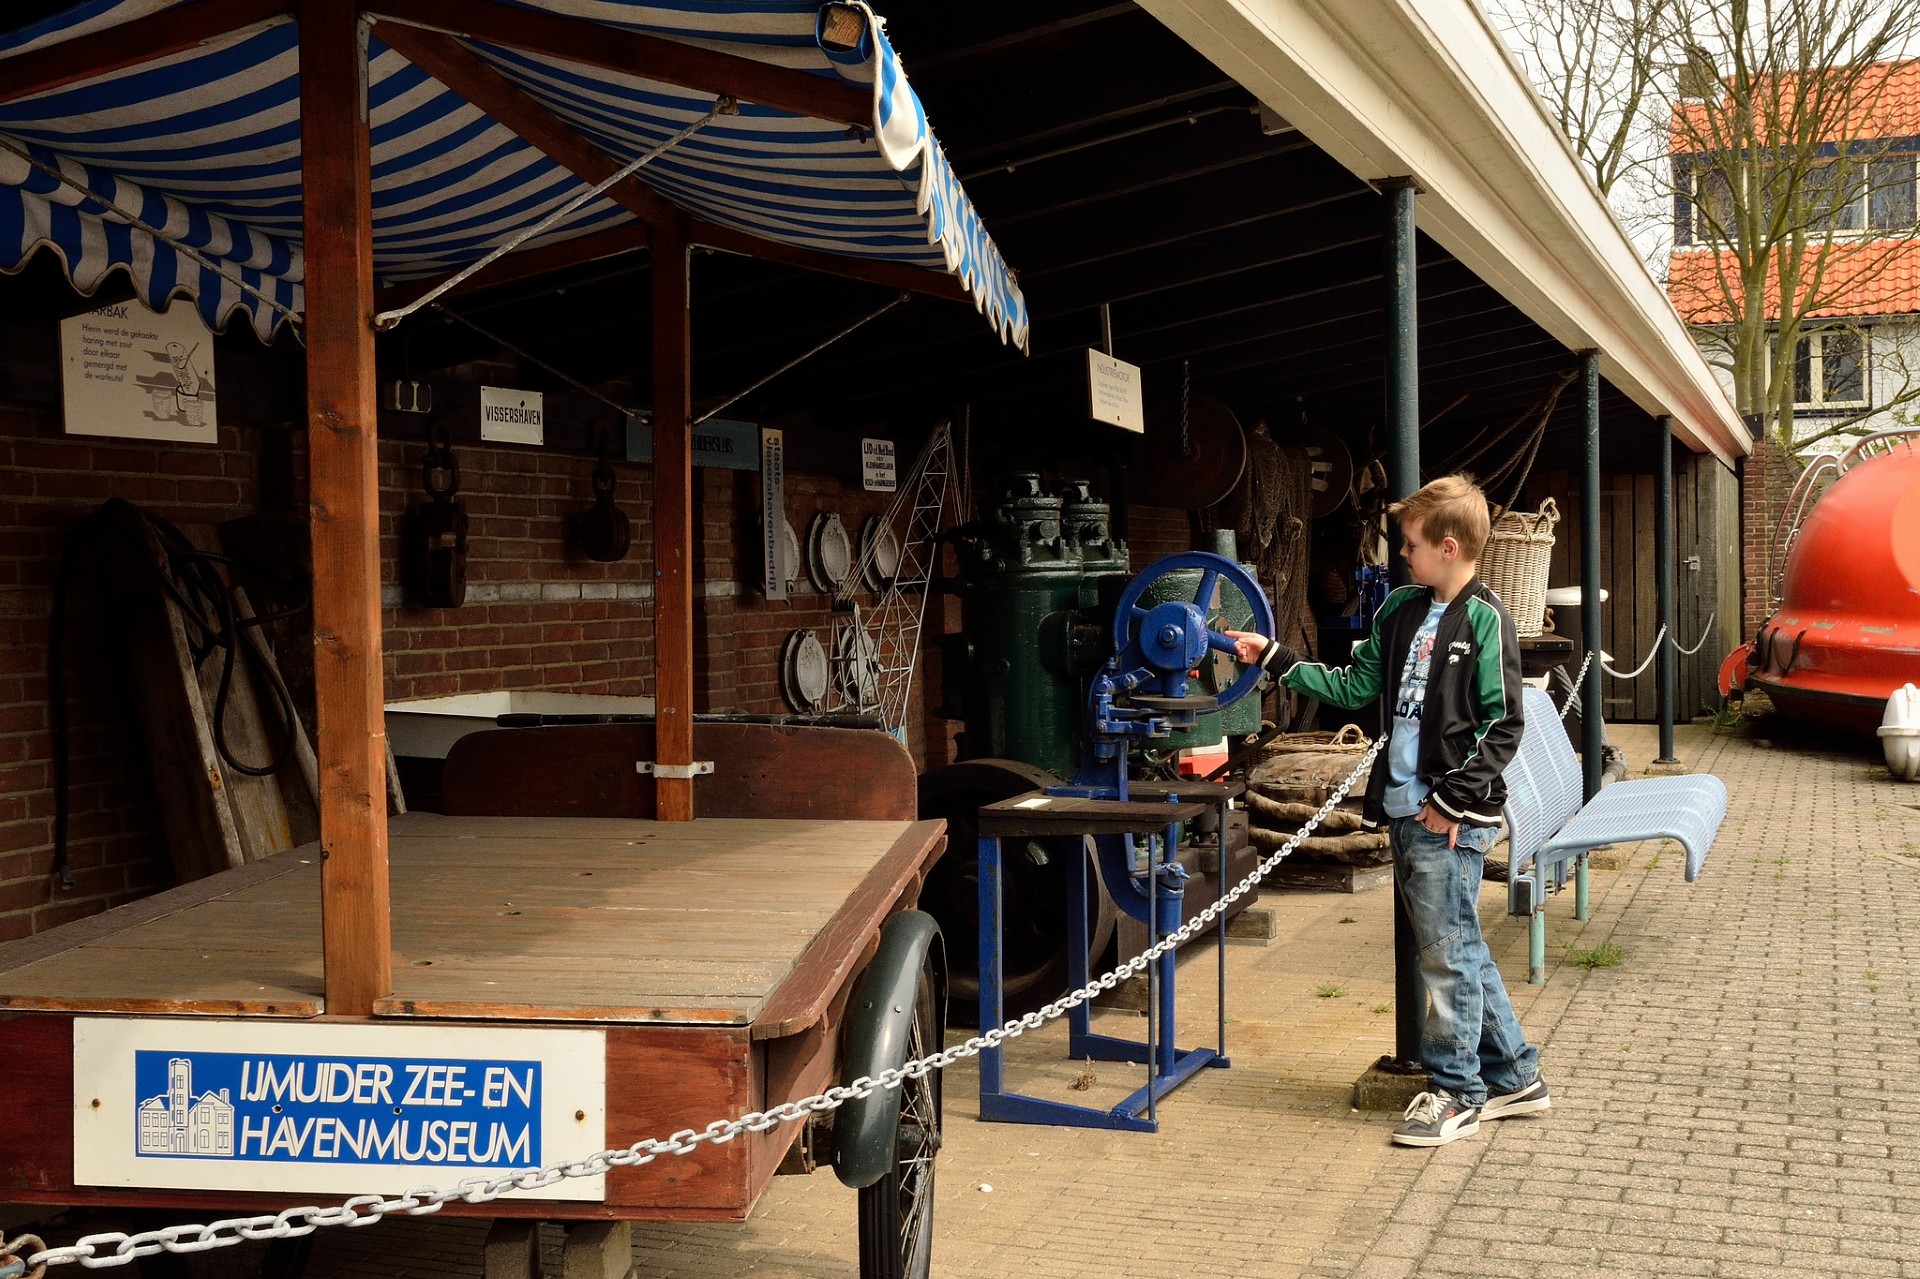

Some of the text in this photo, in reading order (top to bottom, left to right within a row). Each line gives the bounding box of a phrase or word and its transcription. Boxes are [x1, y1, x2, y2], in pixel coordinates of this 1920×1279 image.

[87, 304, 129, 320] ARBAK
[81, 322, 159, 341] Hierin werd de gekaakte
[81, 334, 133, 349] haring met zout
[82, 346, 121, 360] door elkaar
[83, 359, 128, 372] gemengd met
[84, 370, 94, 380] de
[485, 405, 541, 426] VISSERSHAVEN
[240, 1060, 534, 1110] IJMUIDER ZEE- EN
[239, 1116, 531, 1163] HAVENMUSEUM
